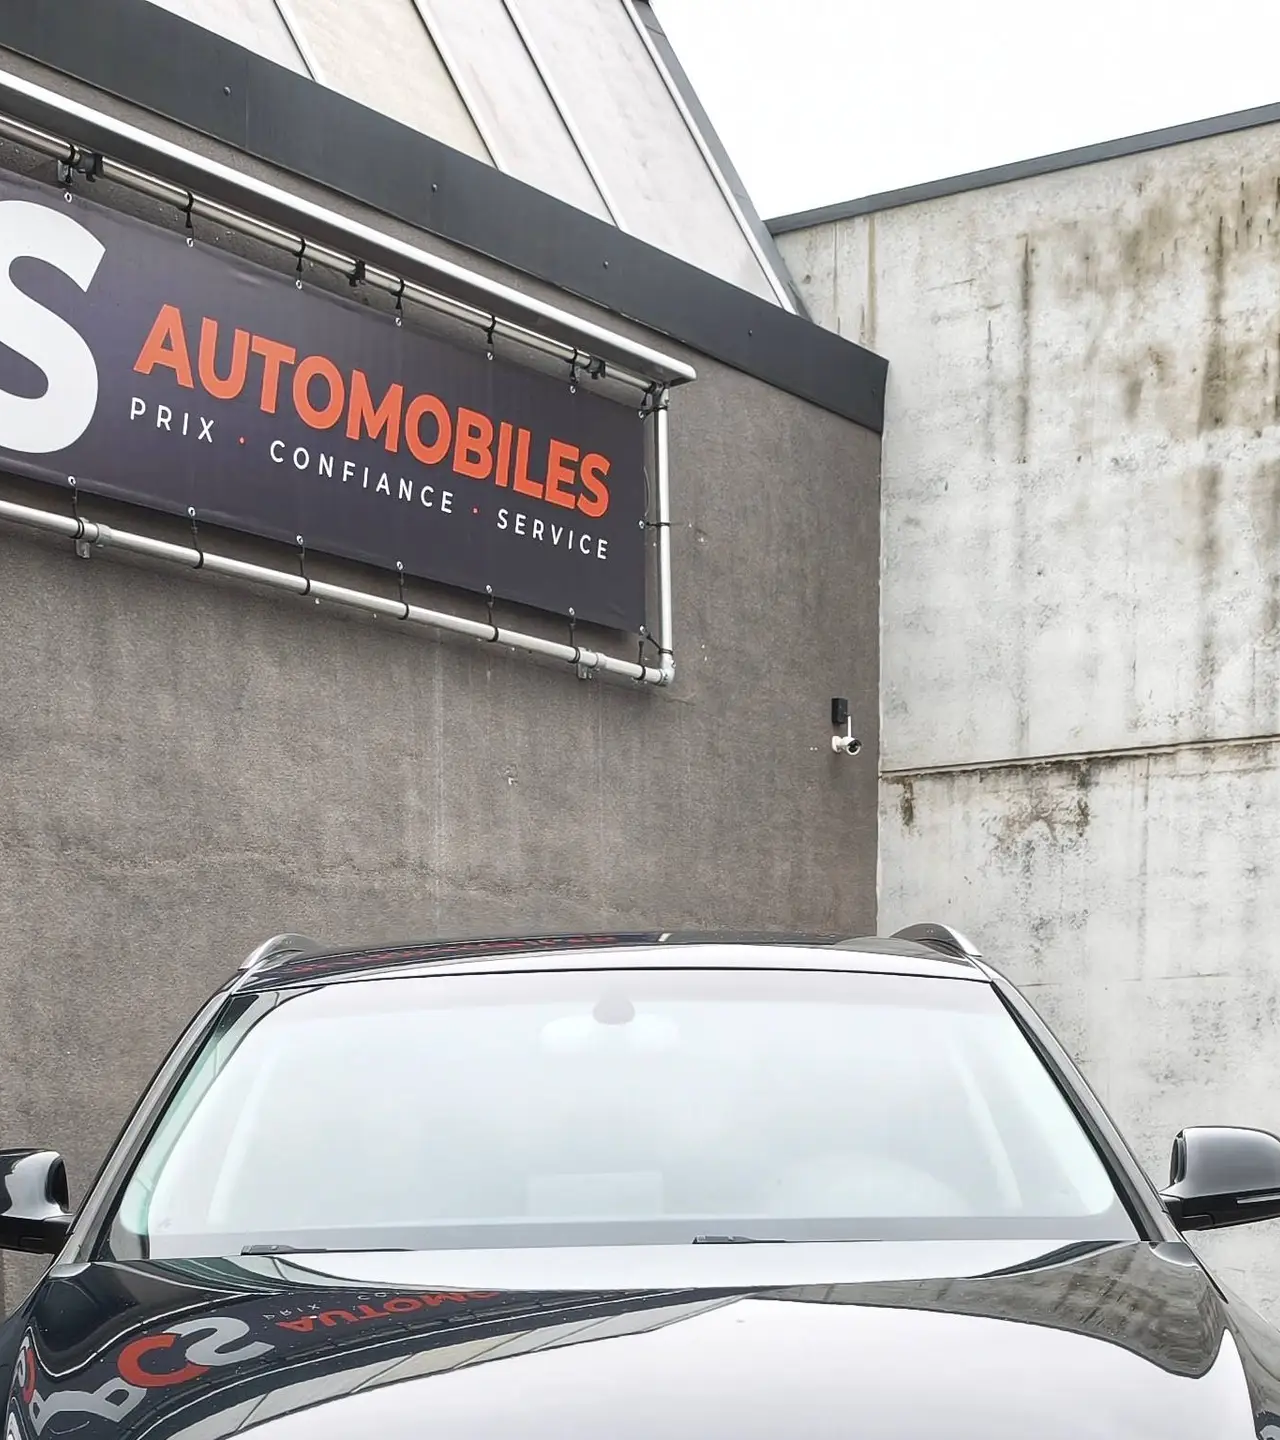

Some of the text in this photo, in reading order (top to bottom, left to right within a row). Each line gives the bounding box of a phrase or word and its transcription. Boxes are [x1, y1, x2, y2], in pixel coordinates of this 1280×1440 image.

[130, 397, 609, 560] PRIX CONFIANCE SERVICE
[133, 304, 611, 518] AUTOMOBILES
